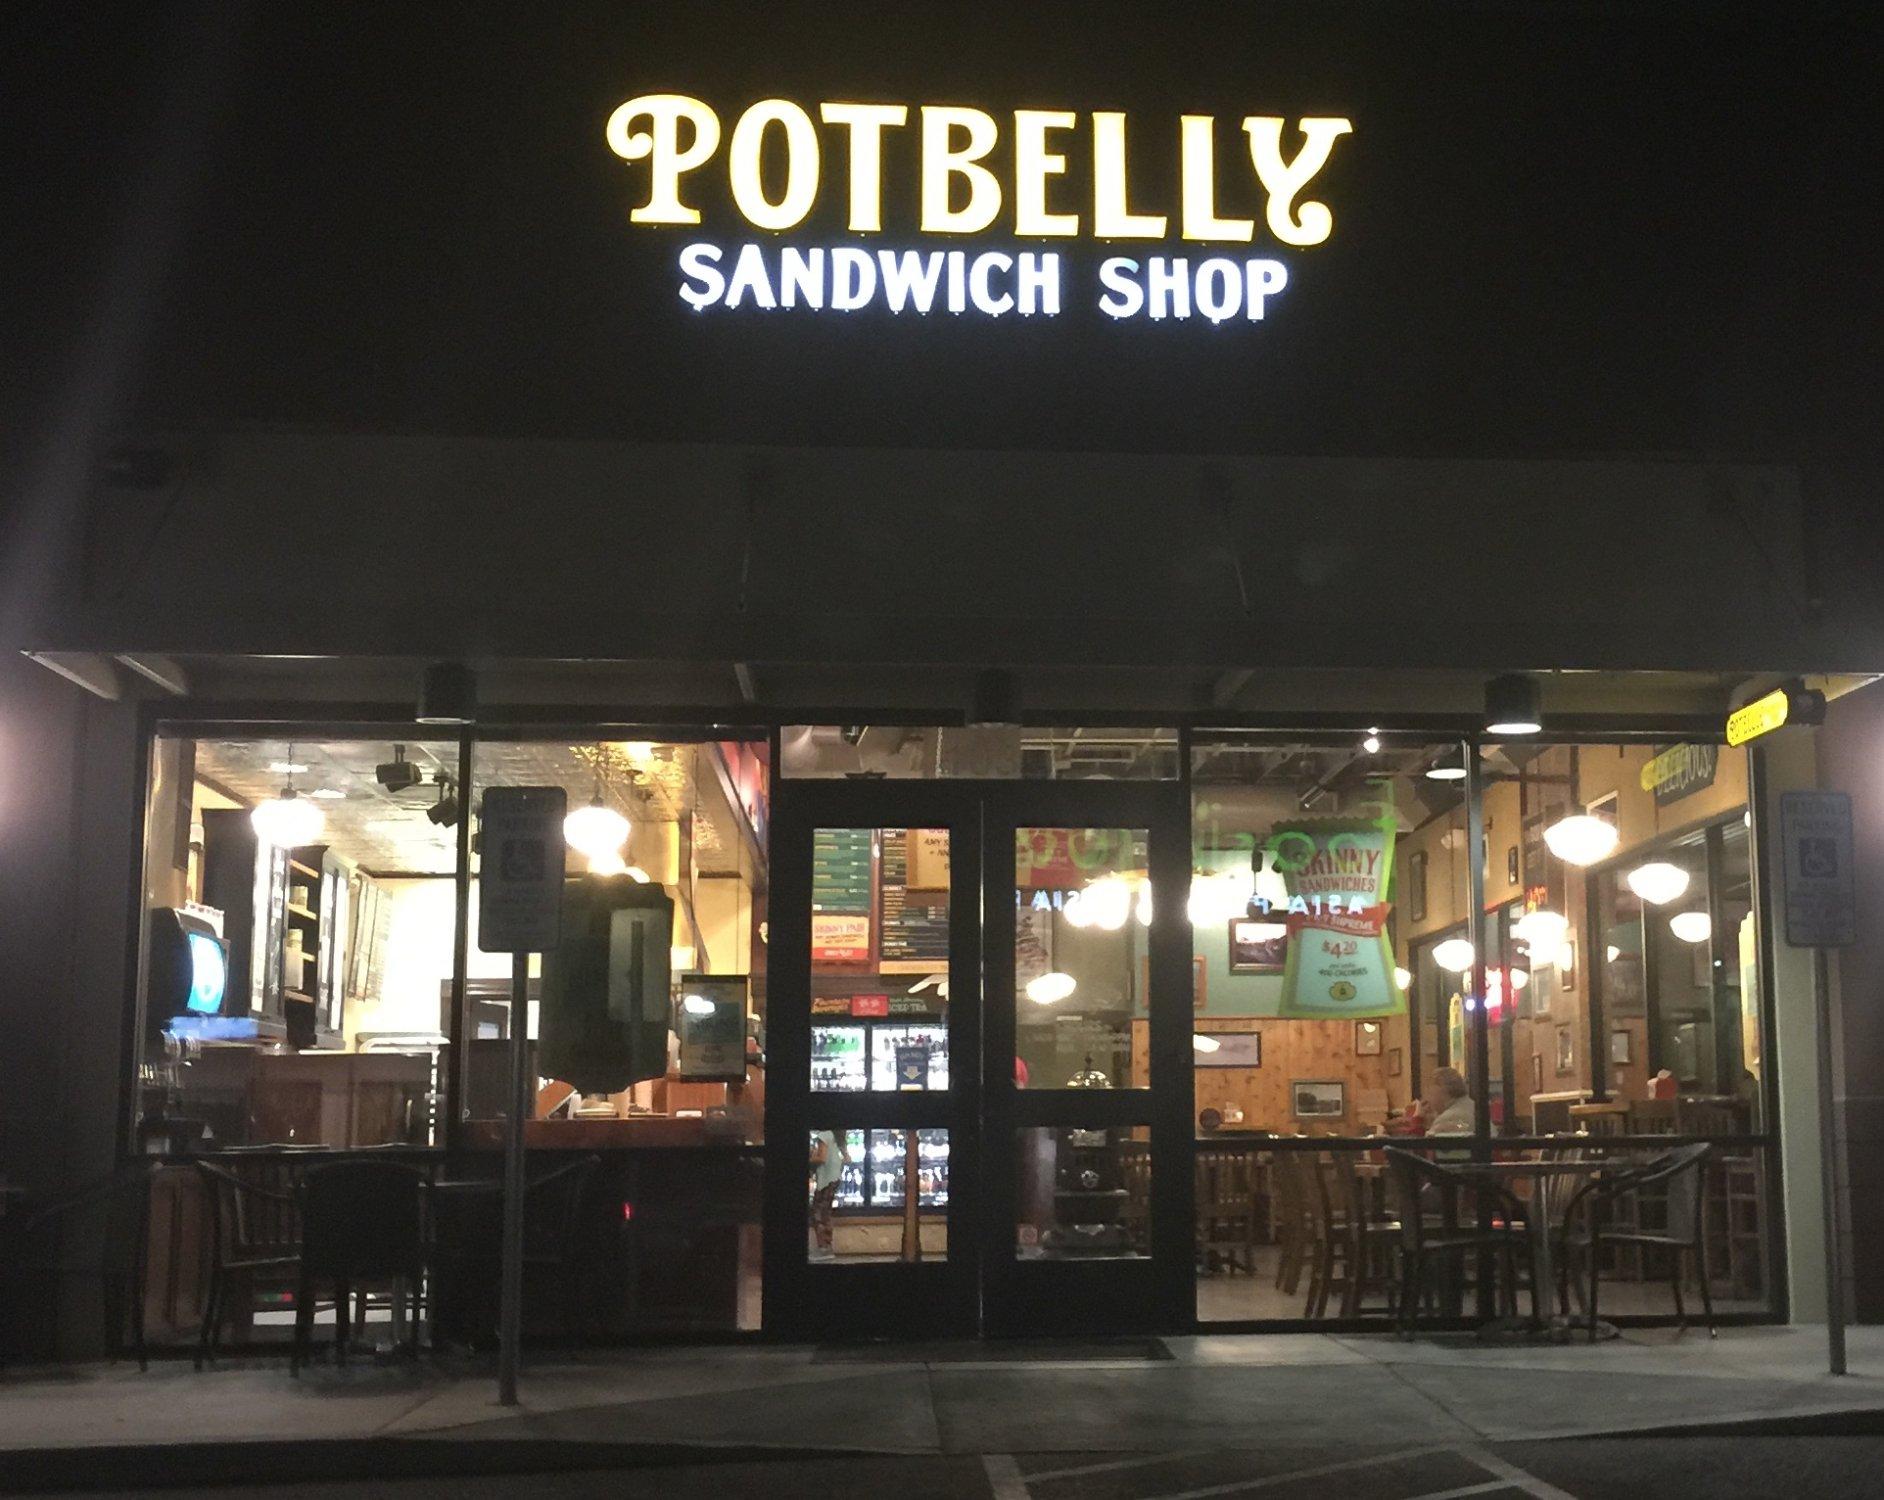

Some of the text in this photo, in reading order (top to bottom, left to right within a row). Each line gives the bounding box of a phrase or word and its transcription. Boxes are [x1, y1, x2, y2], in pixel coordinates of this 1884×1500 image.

[606, 94, 1353, 247] POTBELLY
[678, 243, 1289, 323] SANDWICH SHOP
[1299, 876, 1376, 894] SANDWICHES
